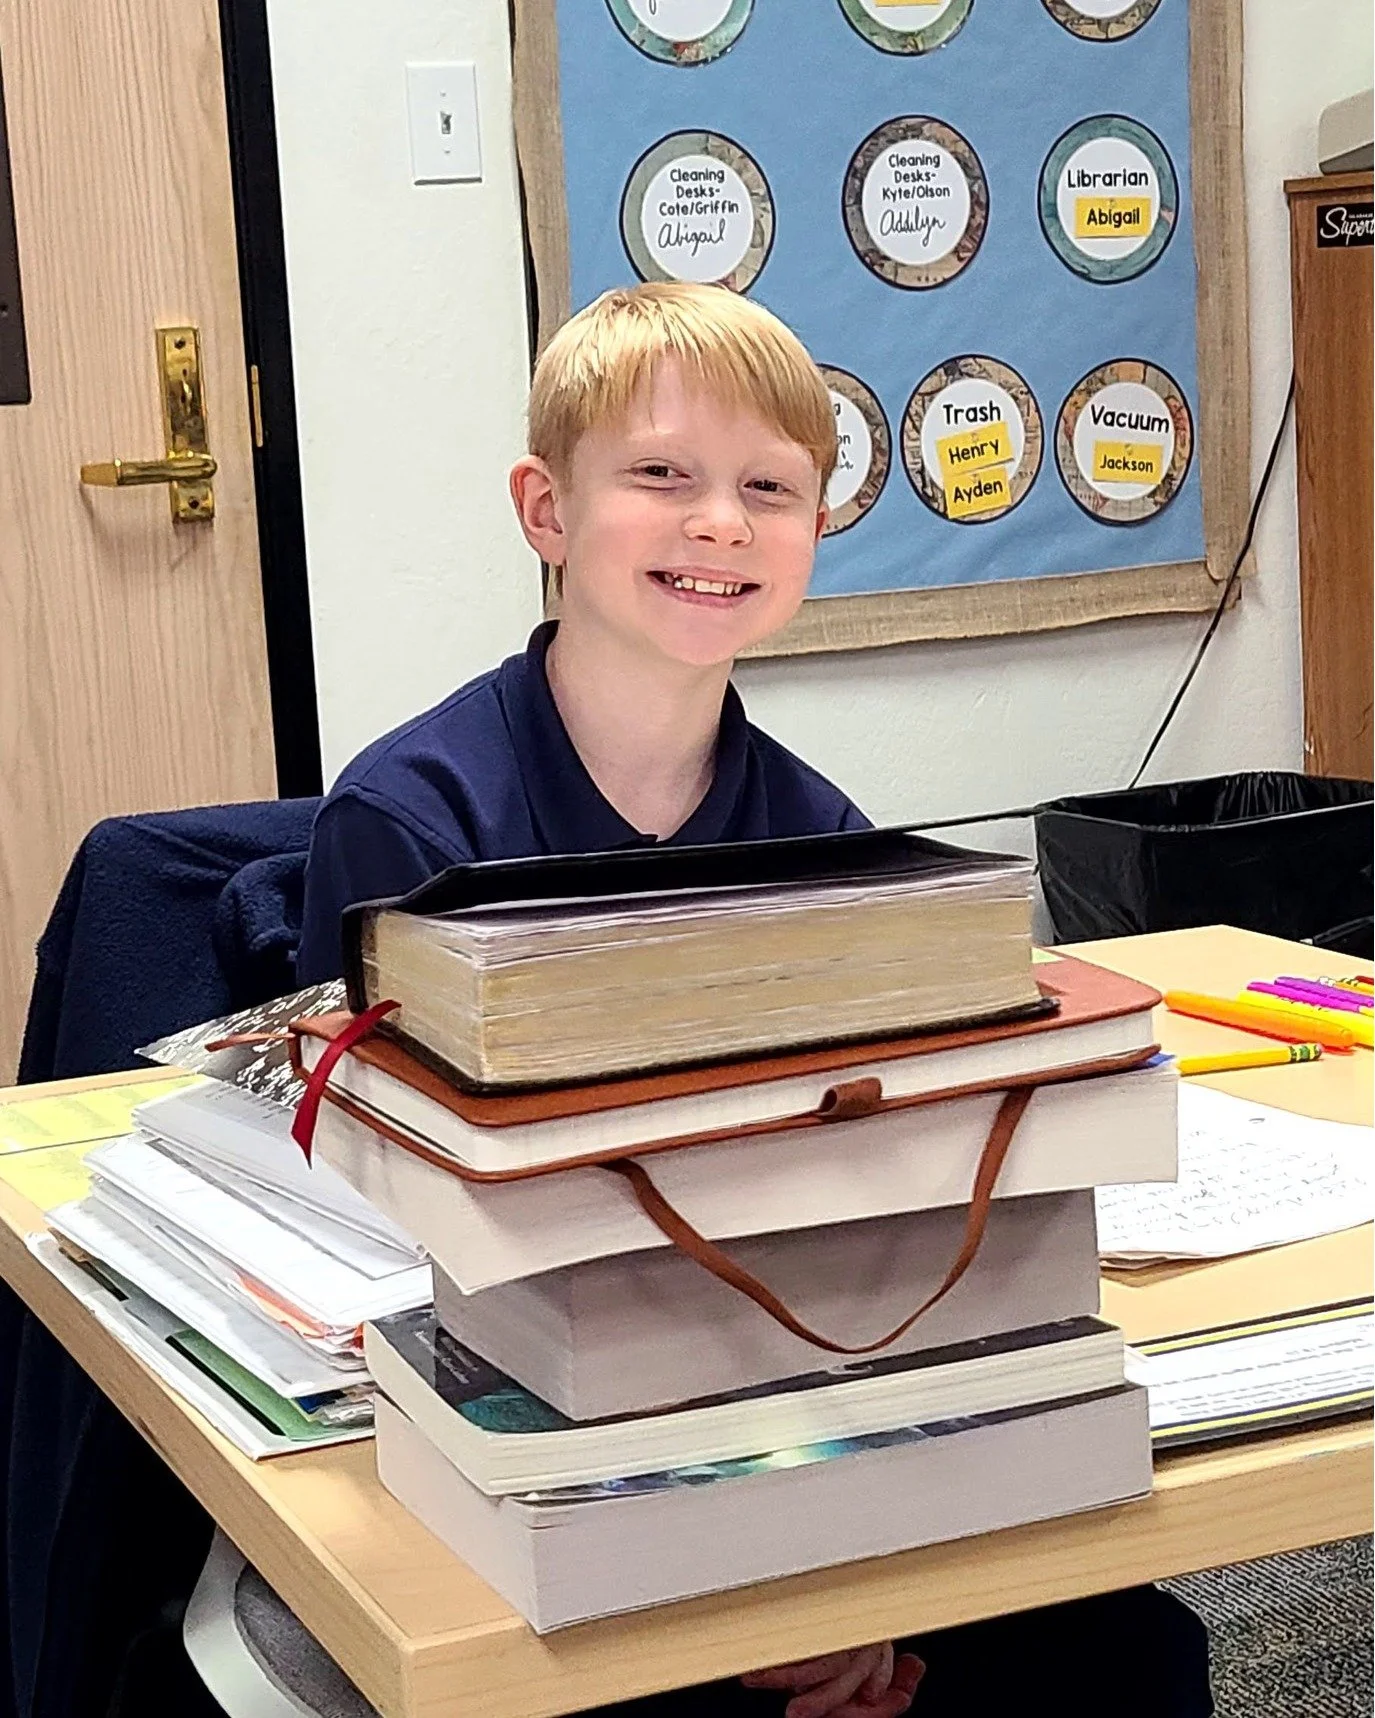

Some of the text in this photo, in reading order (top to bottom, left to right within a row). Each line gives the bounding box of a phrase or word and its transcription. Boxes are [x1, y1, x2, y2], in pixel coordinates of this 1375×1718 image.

[888, 153, 941, 168] Cleaning
[670, 167, 725, 184] Cleaning
[894, 169, 937, 183] Desks-
[1067, 168, 1149, 188] Librarian
[676, 184, 721, 199] Desks-
[882, 184, 951, 202] Kyte/Olson
[1086, 207, 1141, 229] Abigail
[658, 218, 726, 257] Abigail
[943, 400, 1001, 425] Trash
[1091, 404, 1170, 433] Vacuum
[948, 439, 999, 465] Henry
[1099, 454, 1154, 473] Jackson
[953, 480, 1004, 504] Ayden
